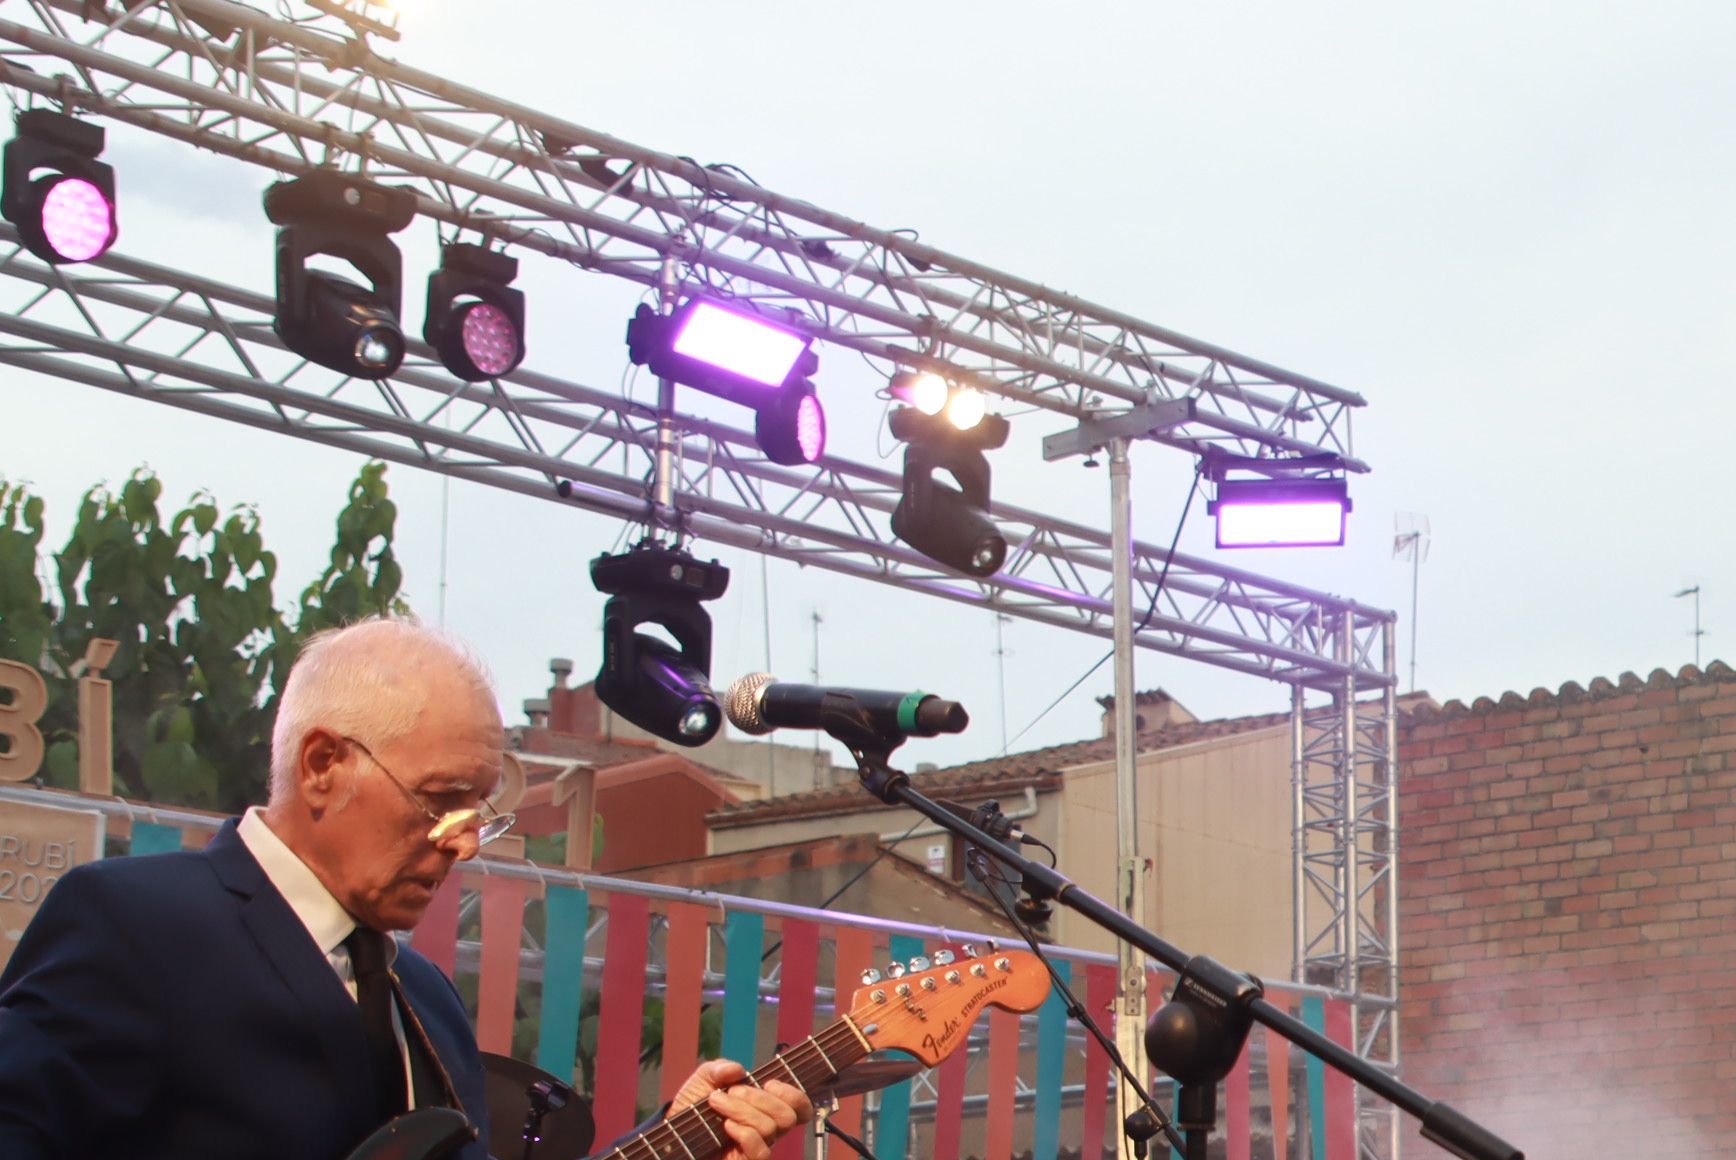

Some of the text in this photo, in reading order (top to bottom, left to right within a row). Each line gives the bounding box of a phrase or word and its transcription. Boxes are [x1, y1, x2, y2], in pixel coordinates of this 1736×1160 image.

[0, 835, 77, 870] RUBÍ
[961, 979, 1007, 1017] STRATOCASTER
[921, 1017, 961, 1059] Fender
